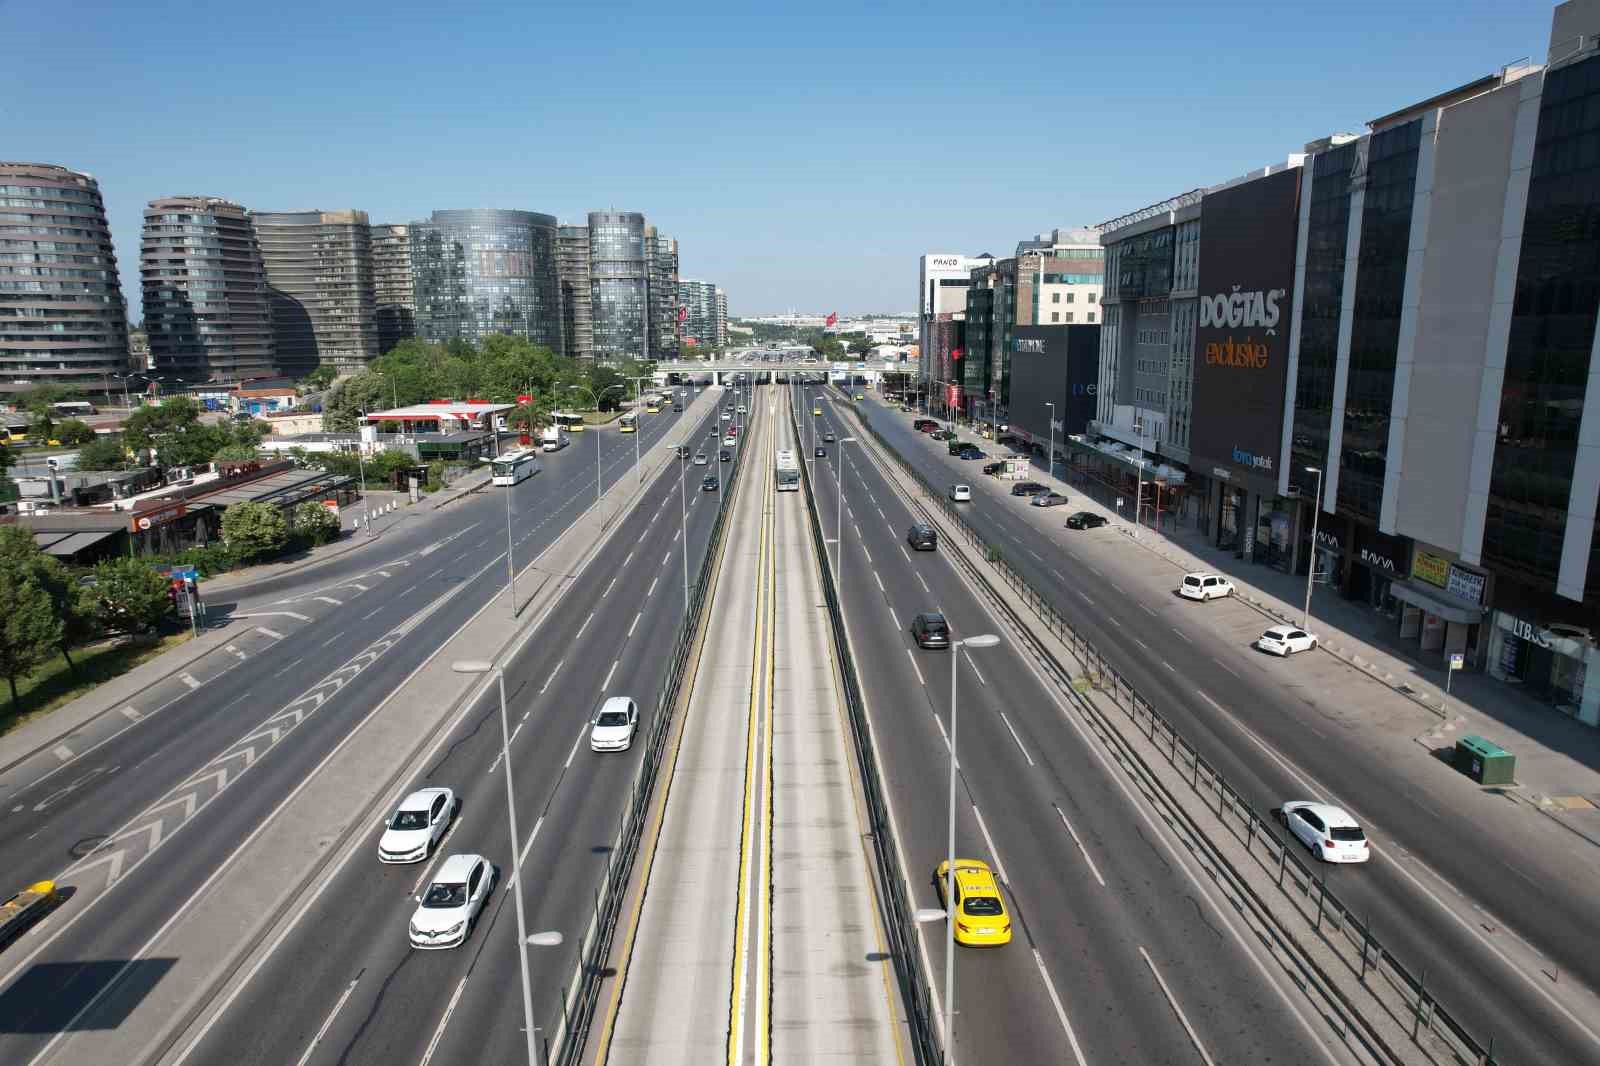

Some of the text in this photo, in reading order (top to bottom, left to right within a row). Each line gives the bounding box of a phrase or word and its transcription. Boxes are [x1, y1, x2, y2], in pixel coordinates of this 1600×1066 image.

[1200, 284, 1280, 336] DOĞTAŞ
[1206, 336, 1268, 368] exclusive
[1513, 617, 1532, 641] LTB
